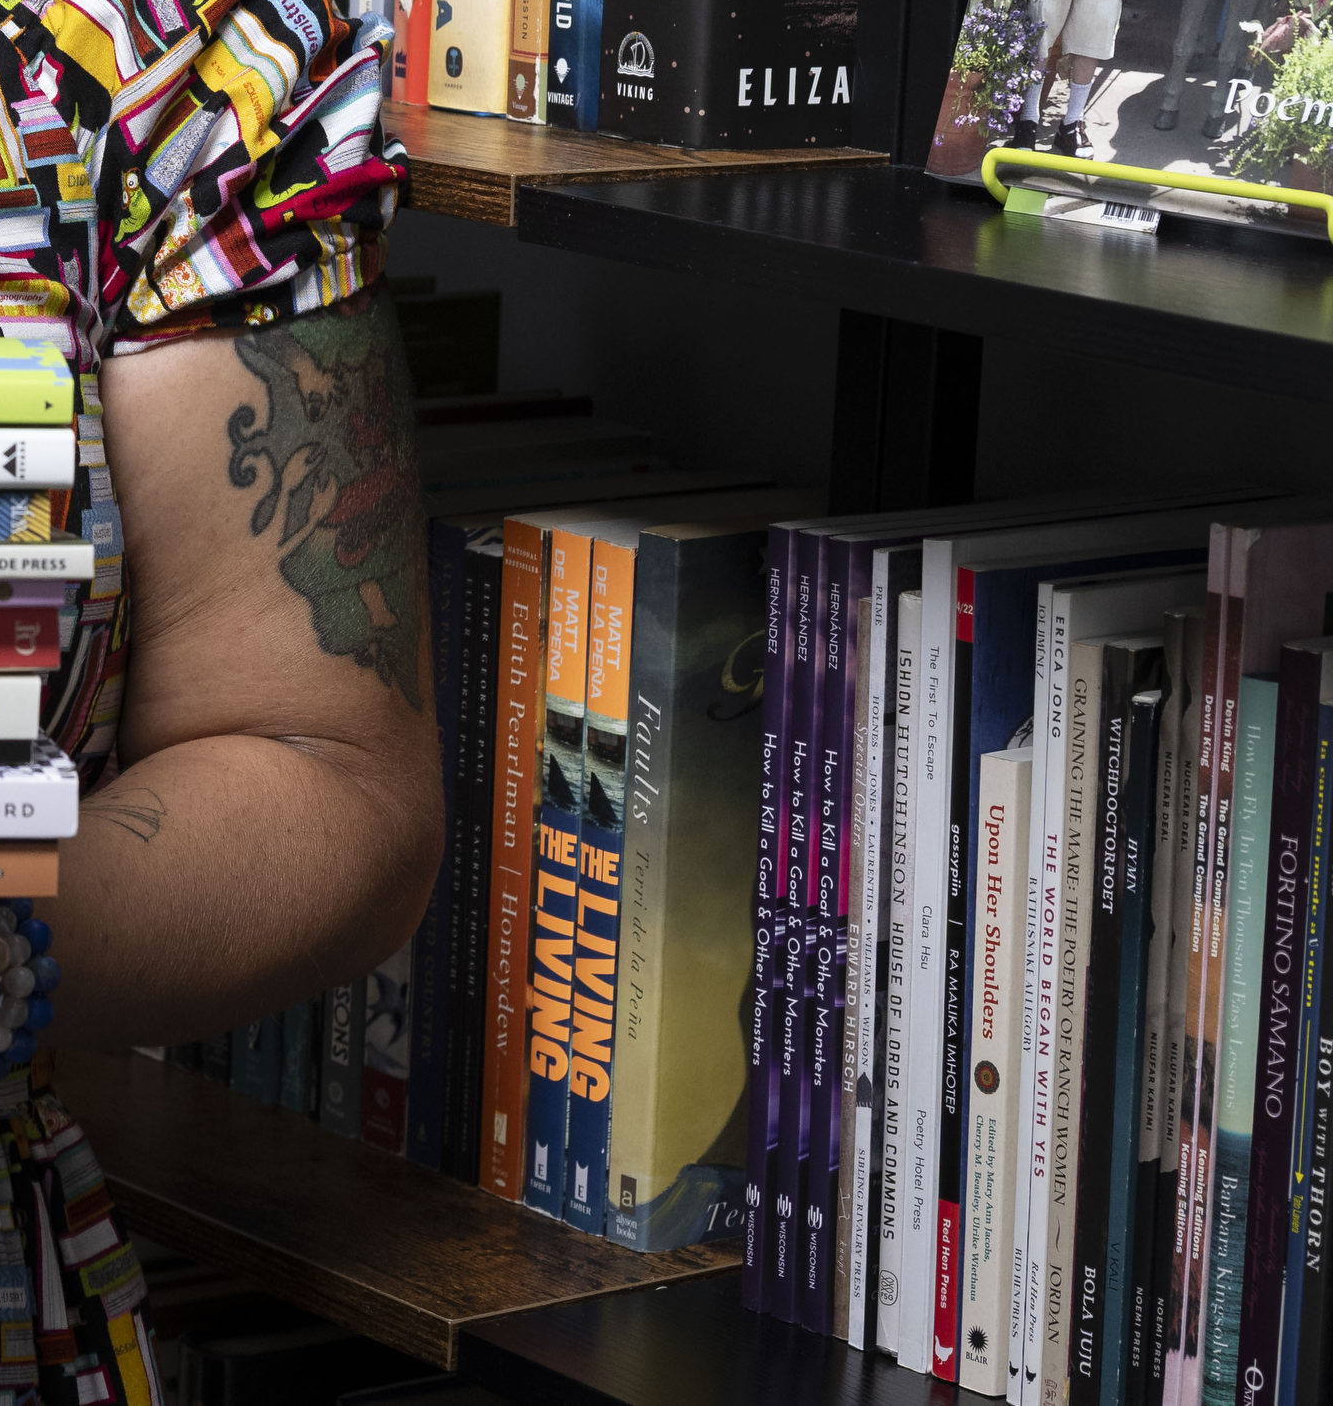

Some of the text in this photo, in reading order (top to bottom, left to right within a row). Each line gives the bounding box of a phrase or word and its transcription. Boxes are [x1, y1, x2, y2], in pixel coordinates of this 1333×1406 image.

[616, 82, 654, 101] VIKING
[738, 66, 852, 106] ELIZA
[21, 558, 67, 572] PRESS
[563, 588, 581, 654] MATT
[828, 582, 840, 670] HERNÁNDEZ
[633, 693, 661, 826] Faults
[1051, 616, 1065, 739] ERICA JONG
[495, 600, 529, 1056] Edith Pearlman Honeydew
[1101, 716, 1123, 915] WITCHDOCTORPOET
[530, 823, 578, 1083] THE LIVING
[569, 841, 620, 1104] THE LIVING
[813, 749, 837, 1087] How Kill Goat Other Monsters
[981, 804, 1006, 1041] Upon Her Shoulders
[1264, 834, 1299, 1119] FORTINO SÁMANO
[1033, 833, 1058, 1178] THE WORLD BEGAN WITH YES
[965, 1350, 989, 1366] BLAIR
[1080, 1265, 1097, 1379] BOLA JUJU
[1211, 1175, 1239, 1384] Barbara Kingsolver
